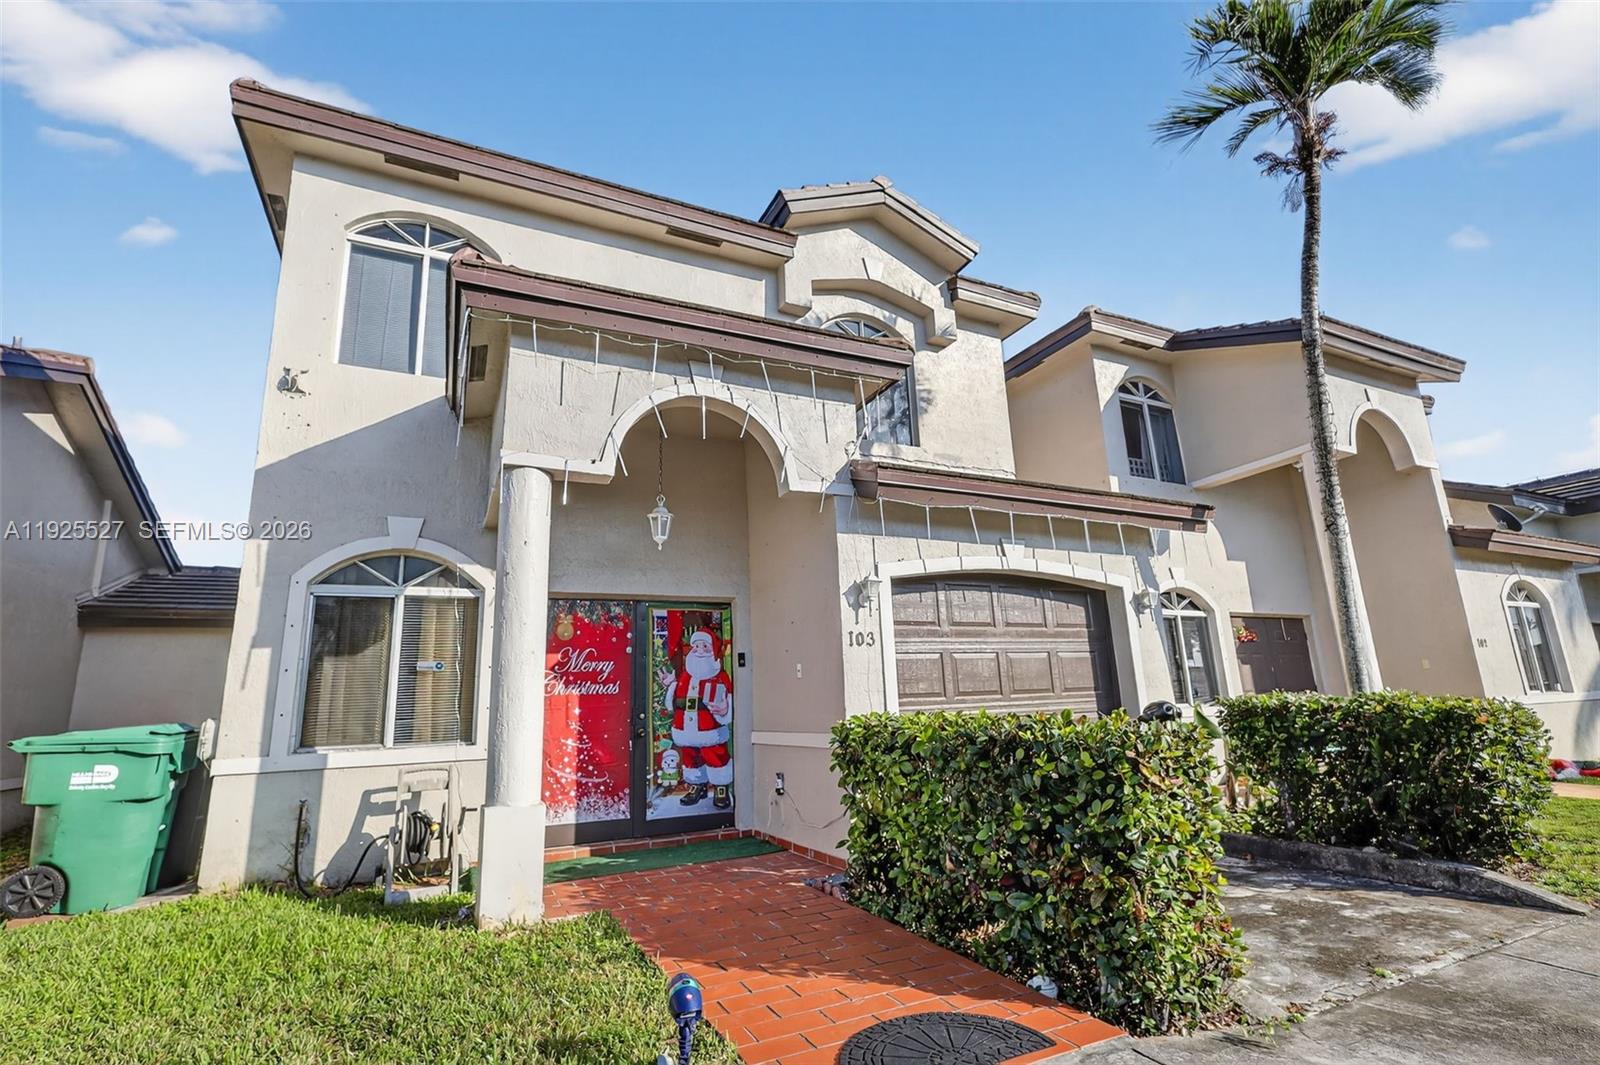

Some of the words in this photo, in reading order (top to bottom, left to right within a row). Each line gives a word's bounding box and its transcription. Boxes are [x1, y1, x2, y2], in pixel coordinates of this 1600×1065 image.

[848, 630, 875, 647] 103
[554, 646, 615, 682] Merry
[544, 669, 621, 697] Christmas
